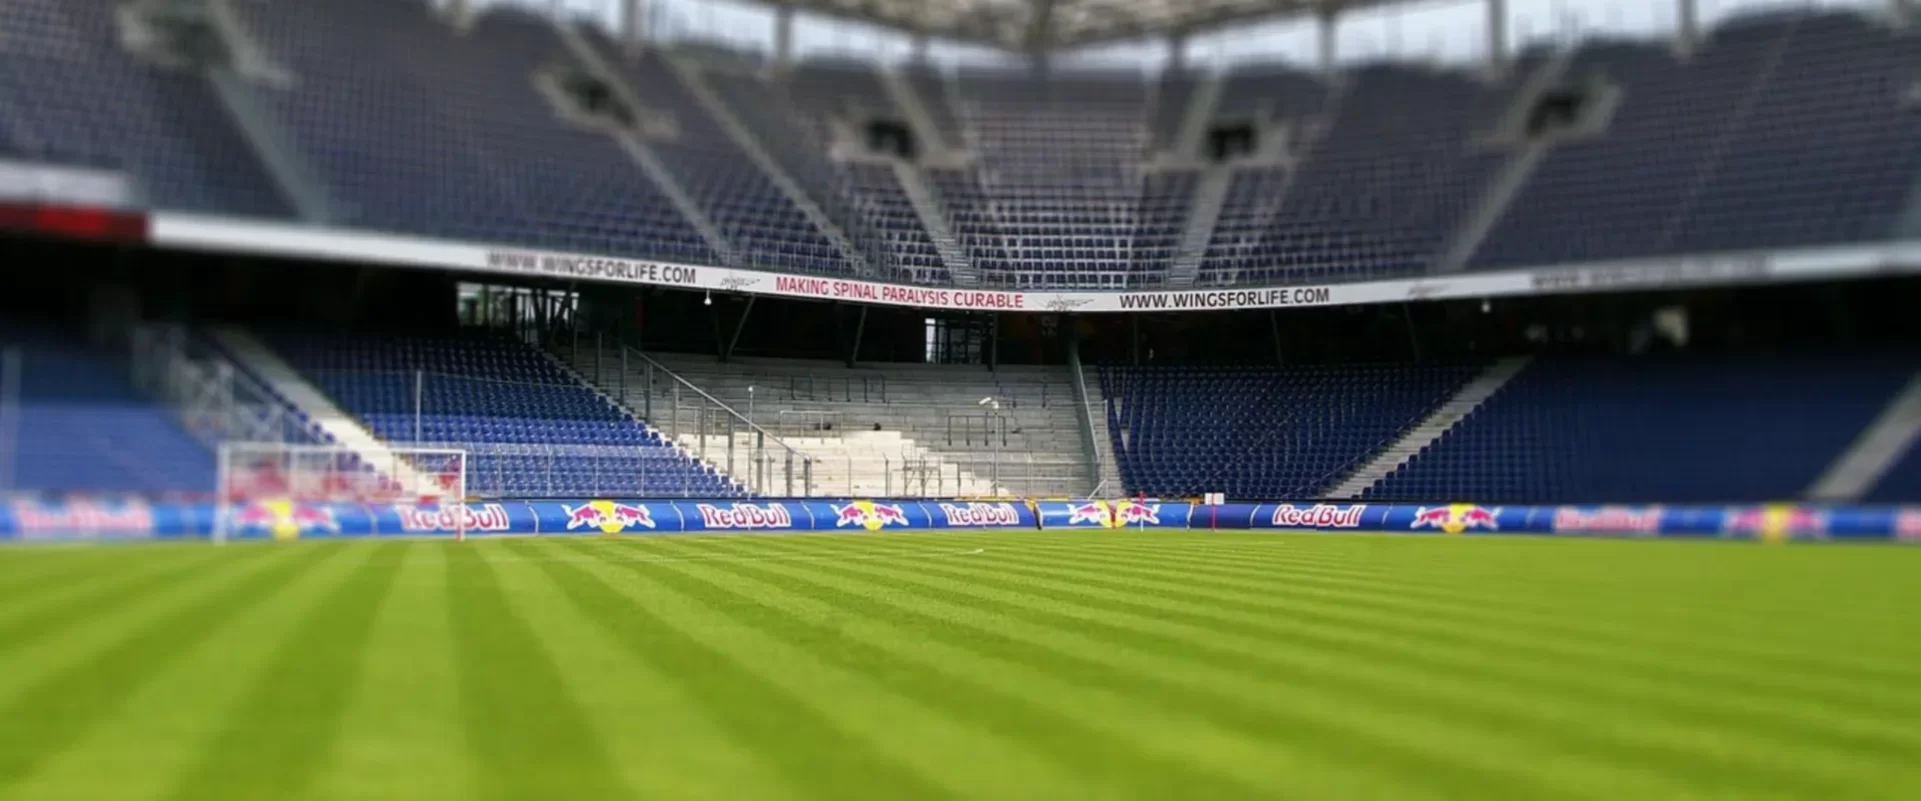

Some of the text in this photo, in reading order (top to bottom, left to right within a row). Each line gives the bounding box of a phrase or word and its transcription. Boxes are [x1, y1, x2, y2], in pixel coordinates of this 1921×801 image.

[775, 276, 829, 296] MAKING
[833, 282, 878, 300] SPINAL
[882, 286, 949, 306] PARALYSIS
[953, 291, 1024, 308] CURABLE
[1119, 288, 1330, 309] WWW.WINGSFORLIFE.COM
